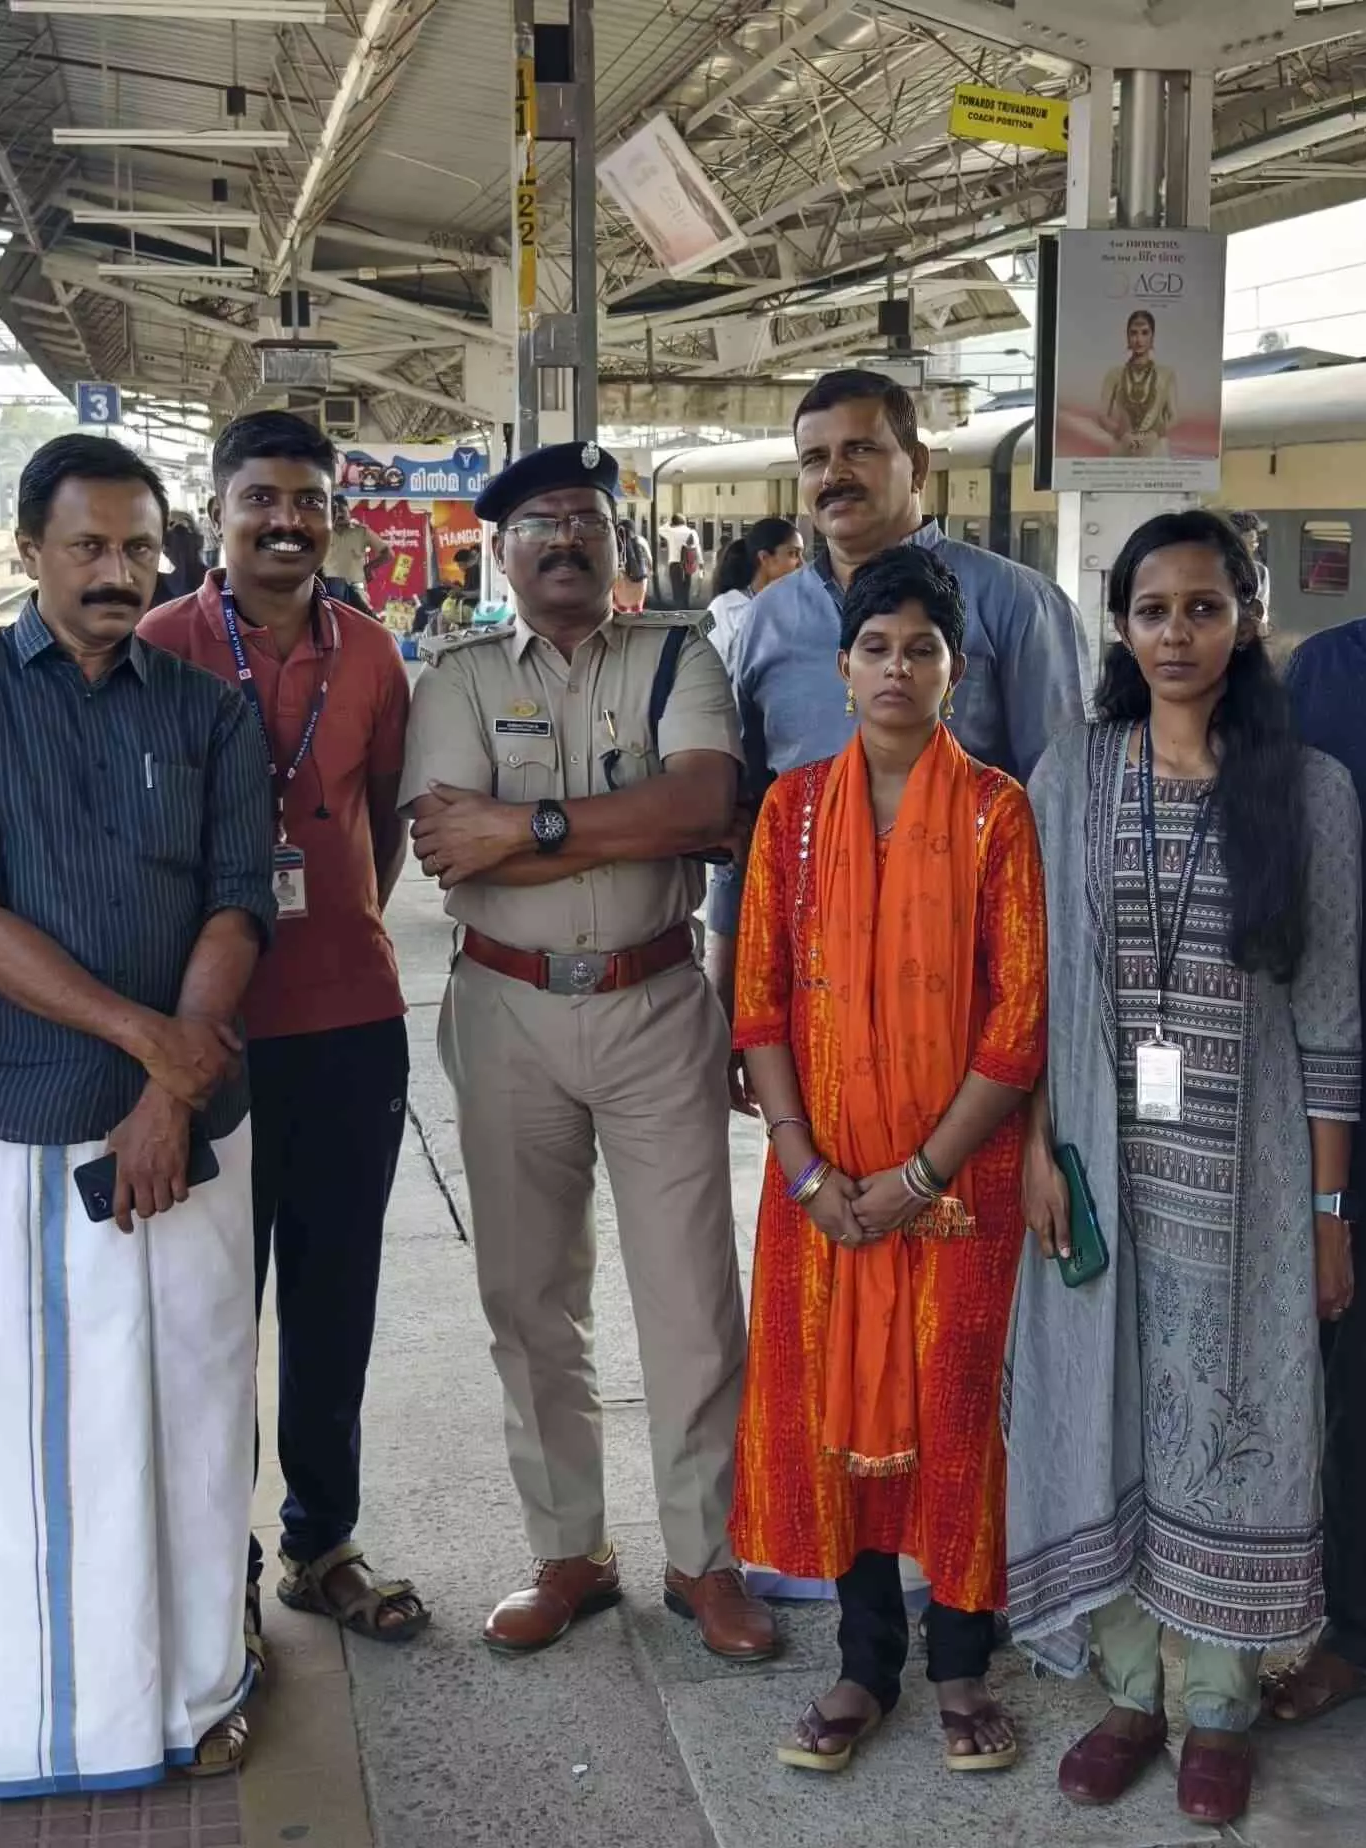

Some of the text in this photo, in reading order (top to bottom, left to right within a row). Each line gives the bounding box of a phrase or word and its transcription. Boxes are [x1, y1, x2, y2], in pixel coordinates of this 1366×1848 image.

[958, 94, 1048, 119] TOWARDS TRIVANDRUM
[967, 111, 1034, 129] COACH POSITION
[1135, 272, 1184, 293] AGD
[90, 393, 109, 421] 3
[1144, 828, 1153, 851] TRUST
[1146, 853, 1156, 910] INTERNATIONAL
